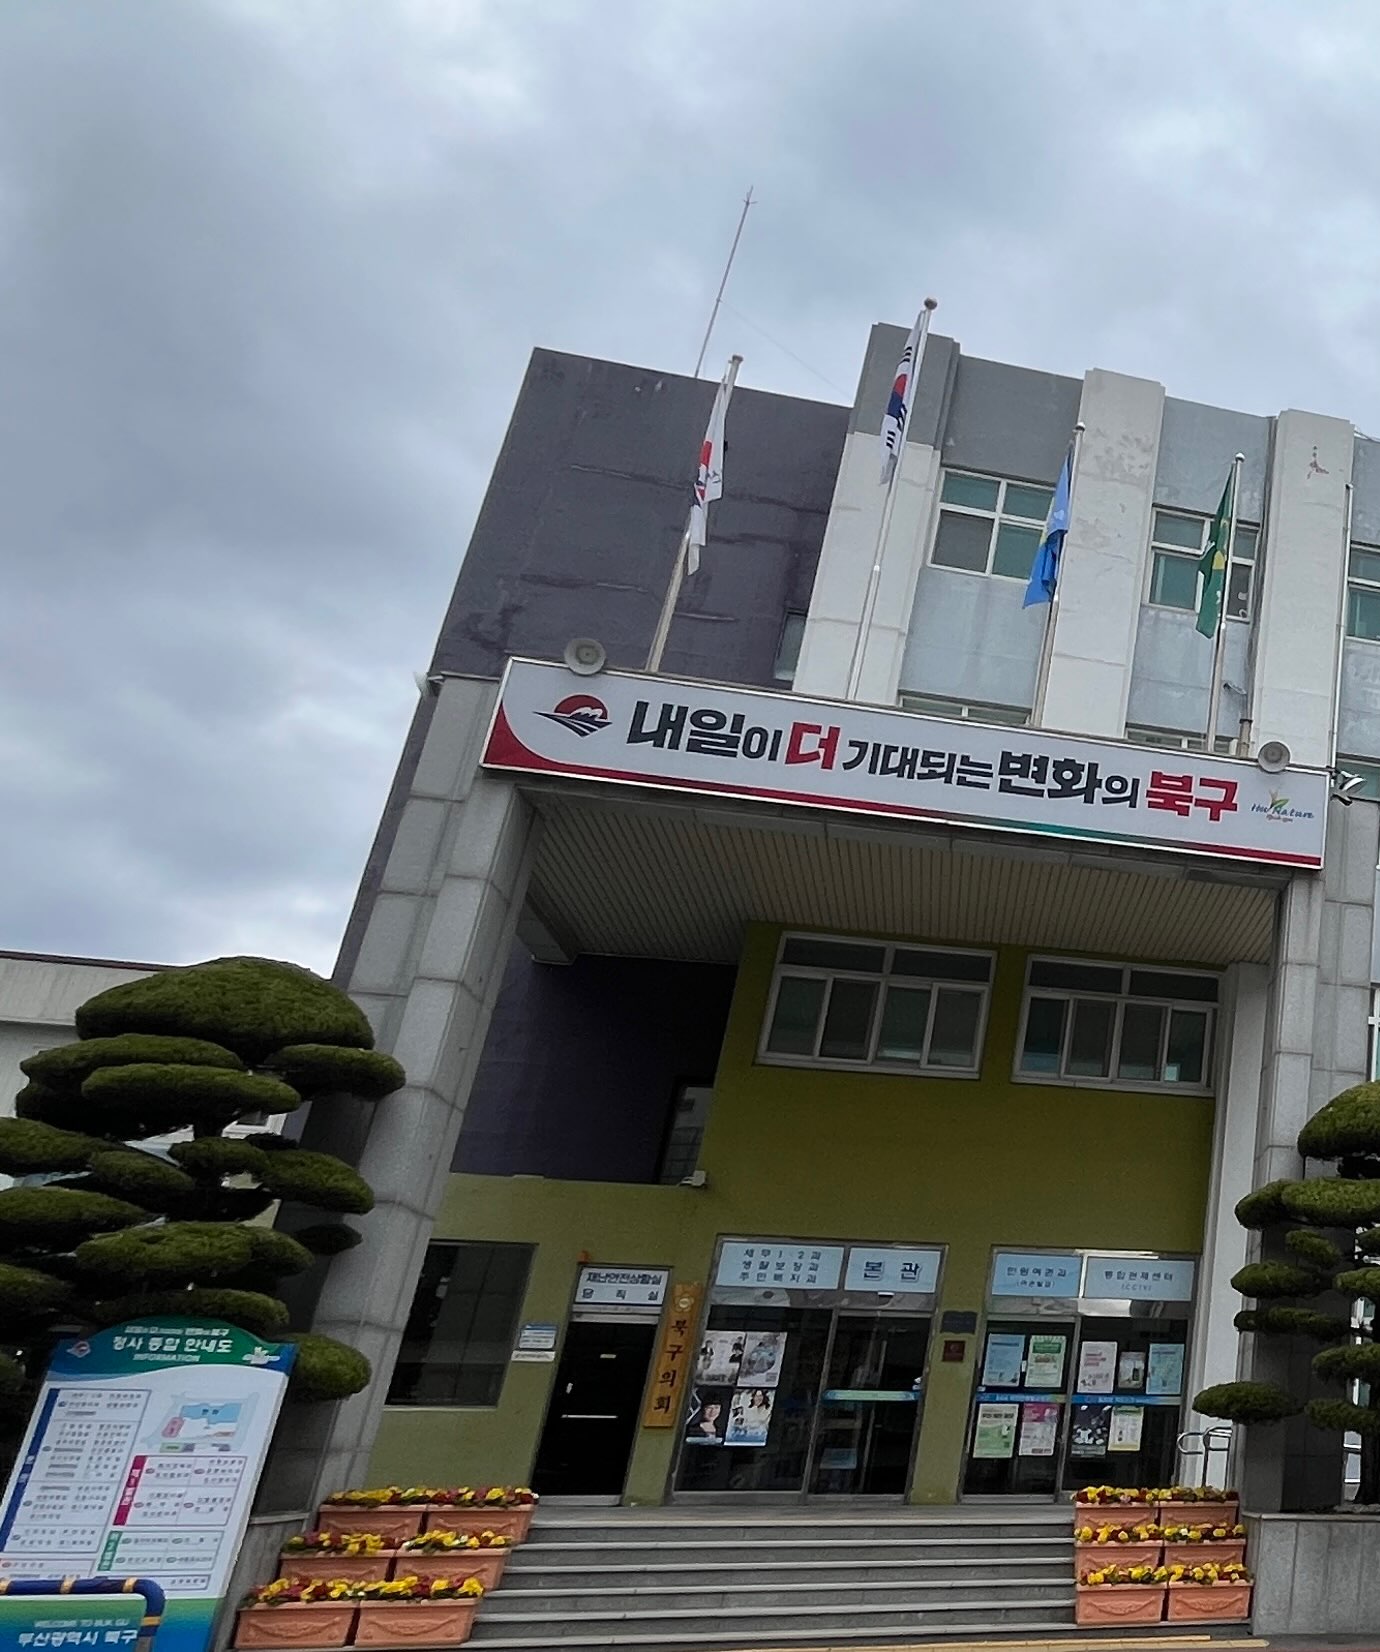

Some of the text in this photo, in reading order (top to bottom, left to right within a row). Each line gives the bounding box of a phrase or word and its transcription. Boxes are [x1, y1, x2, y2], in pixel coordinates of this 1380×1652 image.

[626, 700, 1238, 821] 내일이 더 기대되는 변화의 북구
[183, 1338, 234, 1353] 안내도
[18, 1629, 138, 1647] 부산광역시 북구
